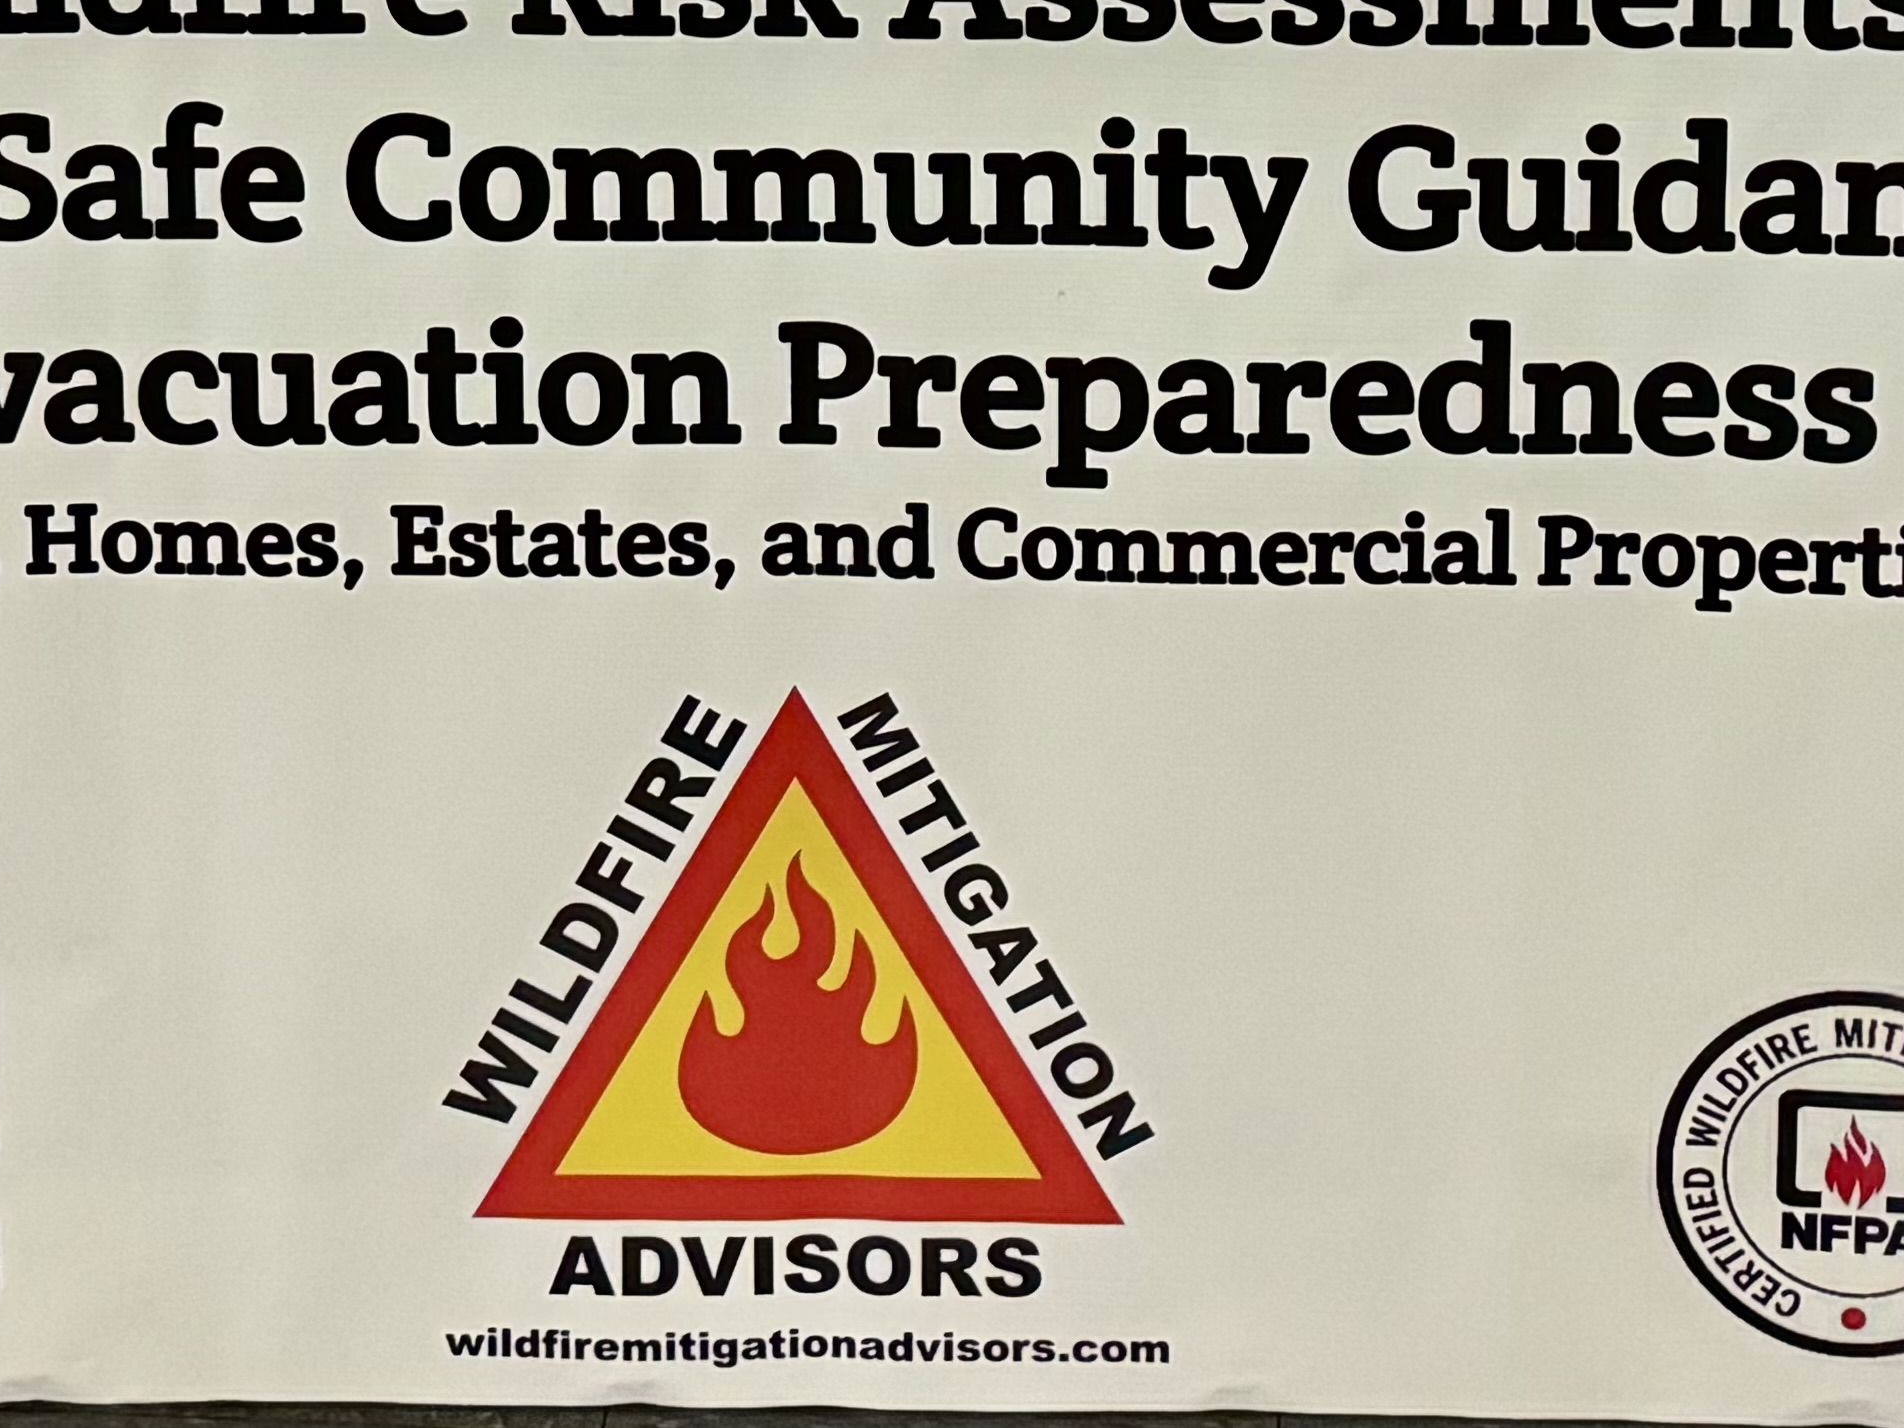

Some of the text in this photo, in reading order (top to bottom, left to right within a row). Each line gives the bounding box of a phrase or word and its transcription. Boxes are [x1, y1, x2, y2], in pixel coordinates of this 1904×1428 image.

[345, 112, 1309, 291] Community
[778, 318, 1878, 490] Preparedness
[23, 503, 364, 591] Homes,
[389, 504, 736, 591] Estates,
[761, 502, 935, 580] and
[957, 506, 1518, 587] Commercial
[442, 695, 748, 1124] WILDFIRE
[837, 692, 1155, 1161] MITIGATION
[1686, 1024, 1818, 1146] WILDFIRE
[548, 1233, 1042, 1298] ADVISORS
[1684, 1167, 1801, 1317] CERTIFIED
[445, 1327, 1170, 1369] wildfiremitigationadvisors.com
